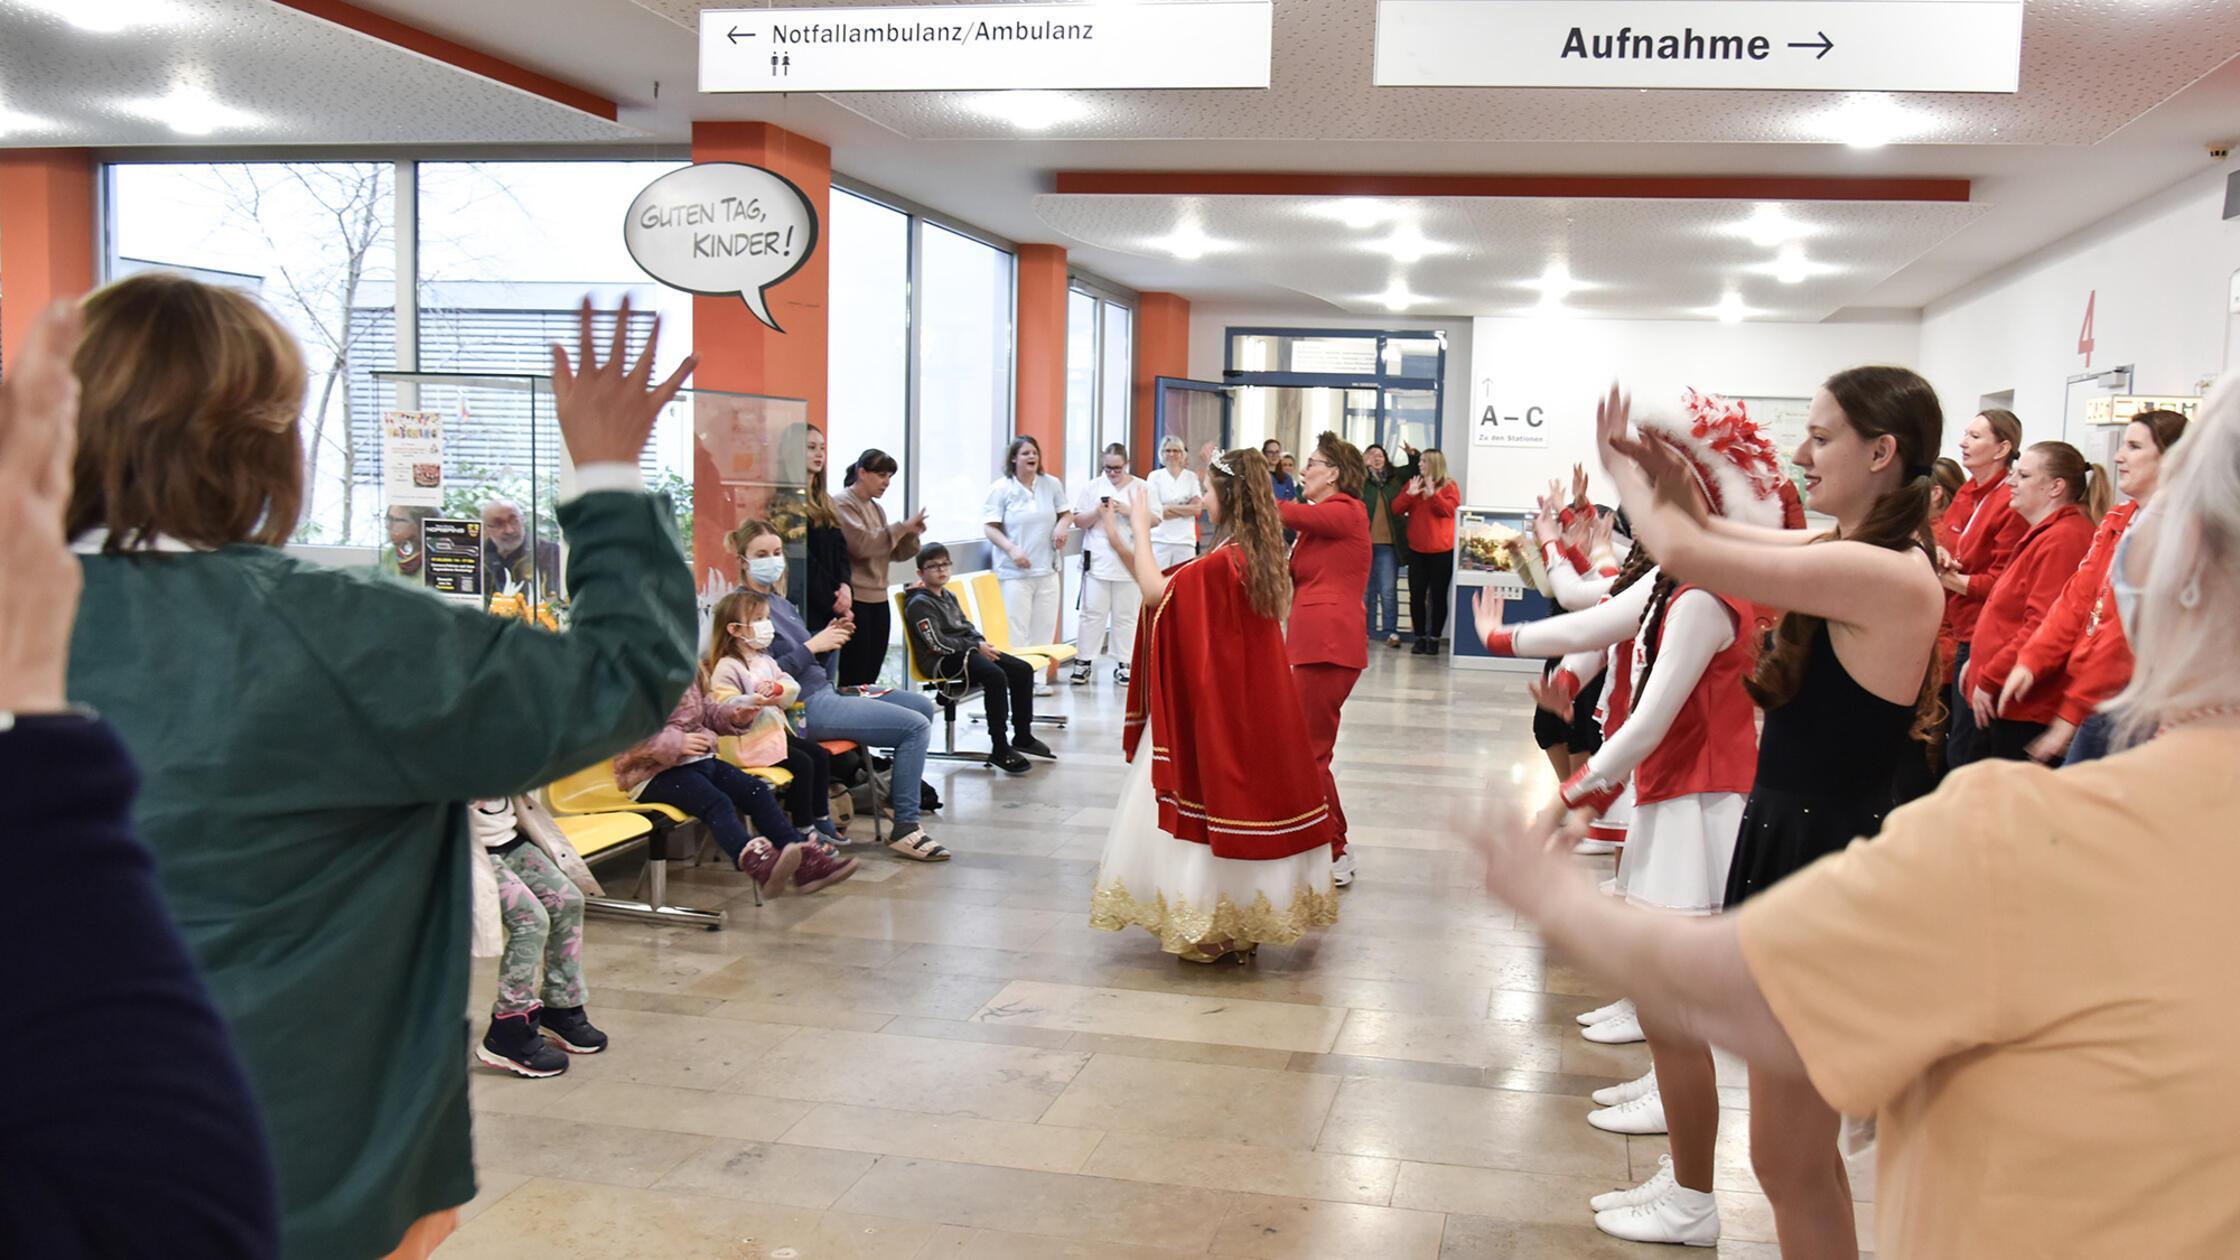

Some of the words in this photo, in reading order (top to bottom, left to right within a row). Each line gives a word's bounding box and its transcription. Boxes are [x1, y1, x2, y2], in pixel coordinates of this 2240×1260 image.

[772, 20, 1094, 45] Notfallambulanz/Ambulanz
[1560, 26, 1771, 60] Aufnahme
[640, 202, 715, 229] GUTEN
[721, 197, 767, 223] TAG,
[693, 225, 794, 258] KINDER!
[2077, 289, 2096, 369] 4
[1480, 405, 1499, 427] A
[1526, 406, 1544, 428] C
[1507, 434, 1544, 443] Stationen
